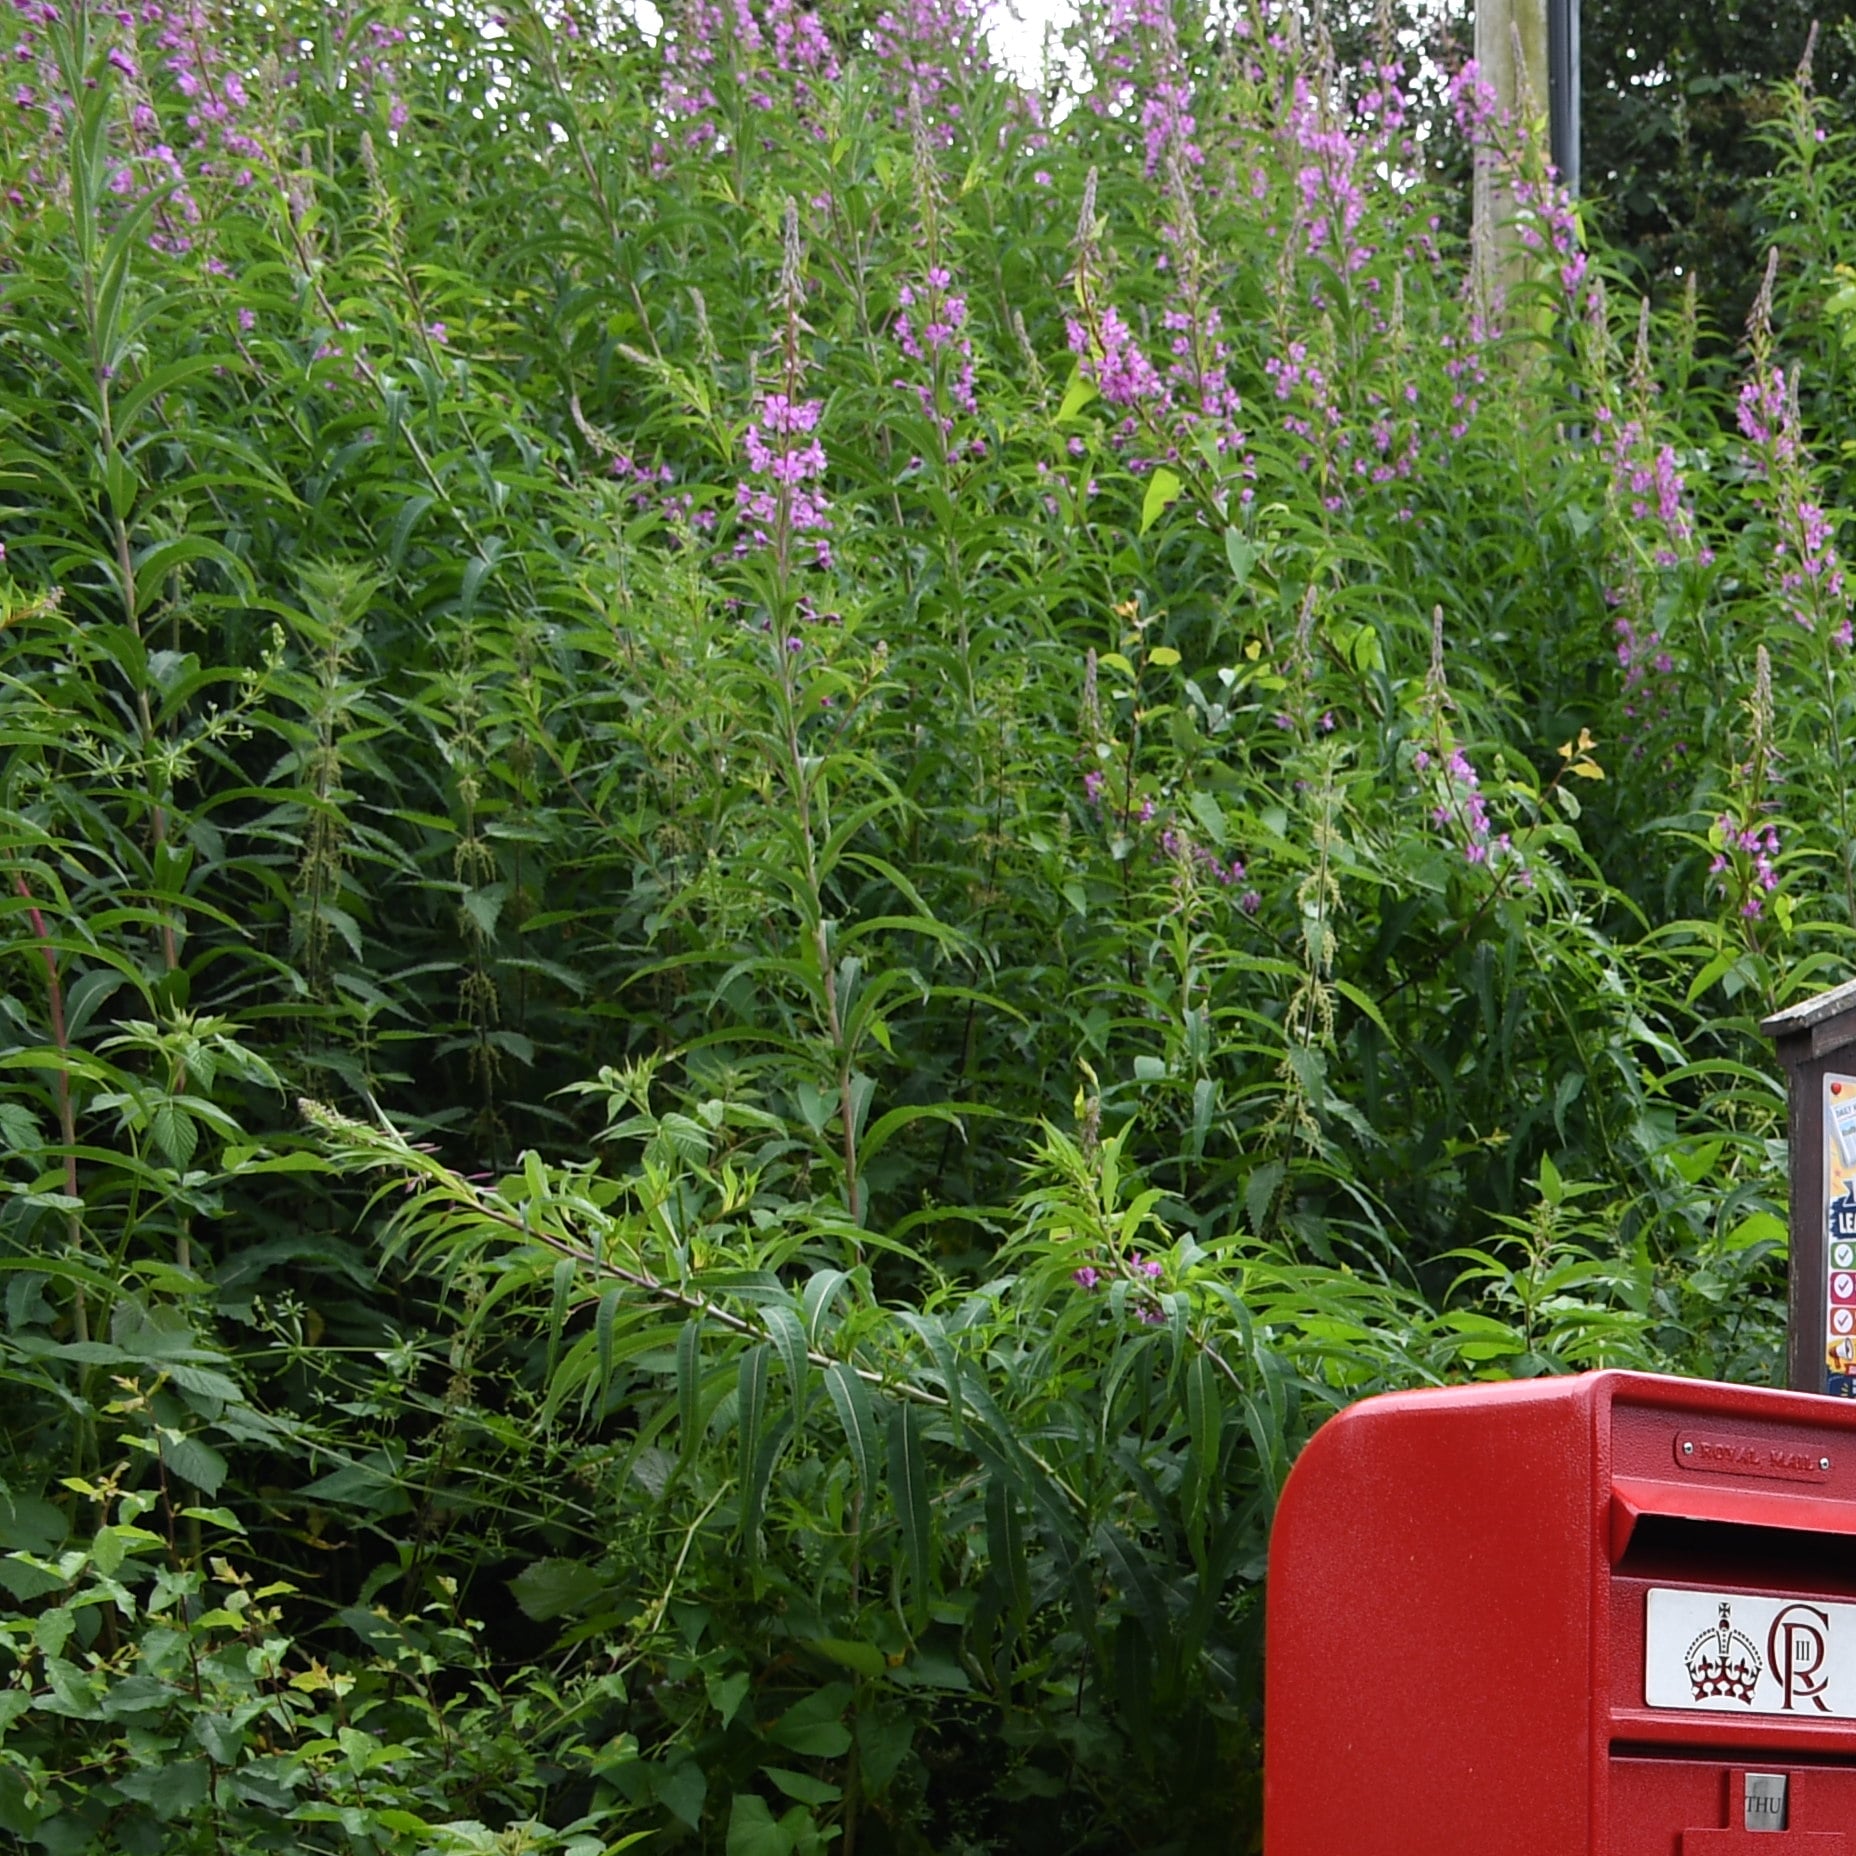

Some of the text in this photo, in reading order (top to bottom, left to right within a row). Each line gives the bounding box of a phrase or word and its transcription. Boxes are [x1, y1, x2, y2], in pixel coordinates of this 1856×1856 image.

[1701, 1442, 1814, 1471] ROYAL MAIL
[1745, 1796, 1781, 1814] THU
